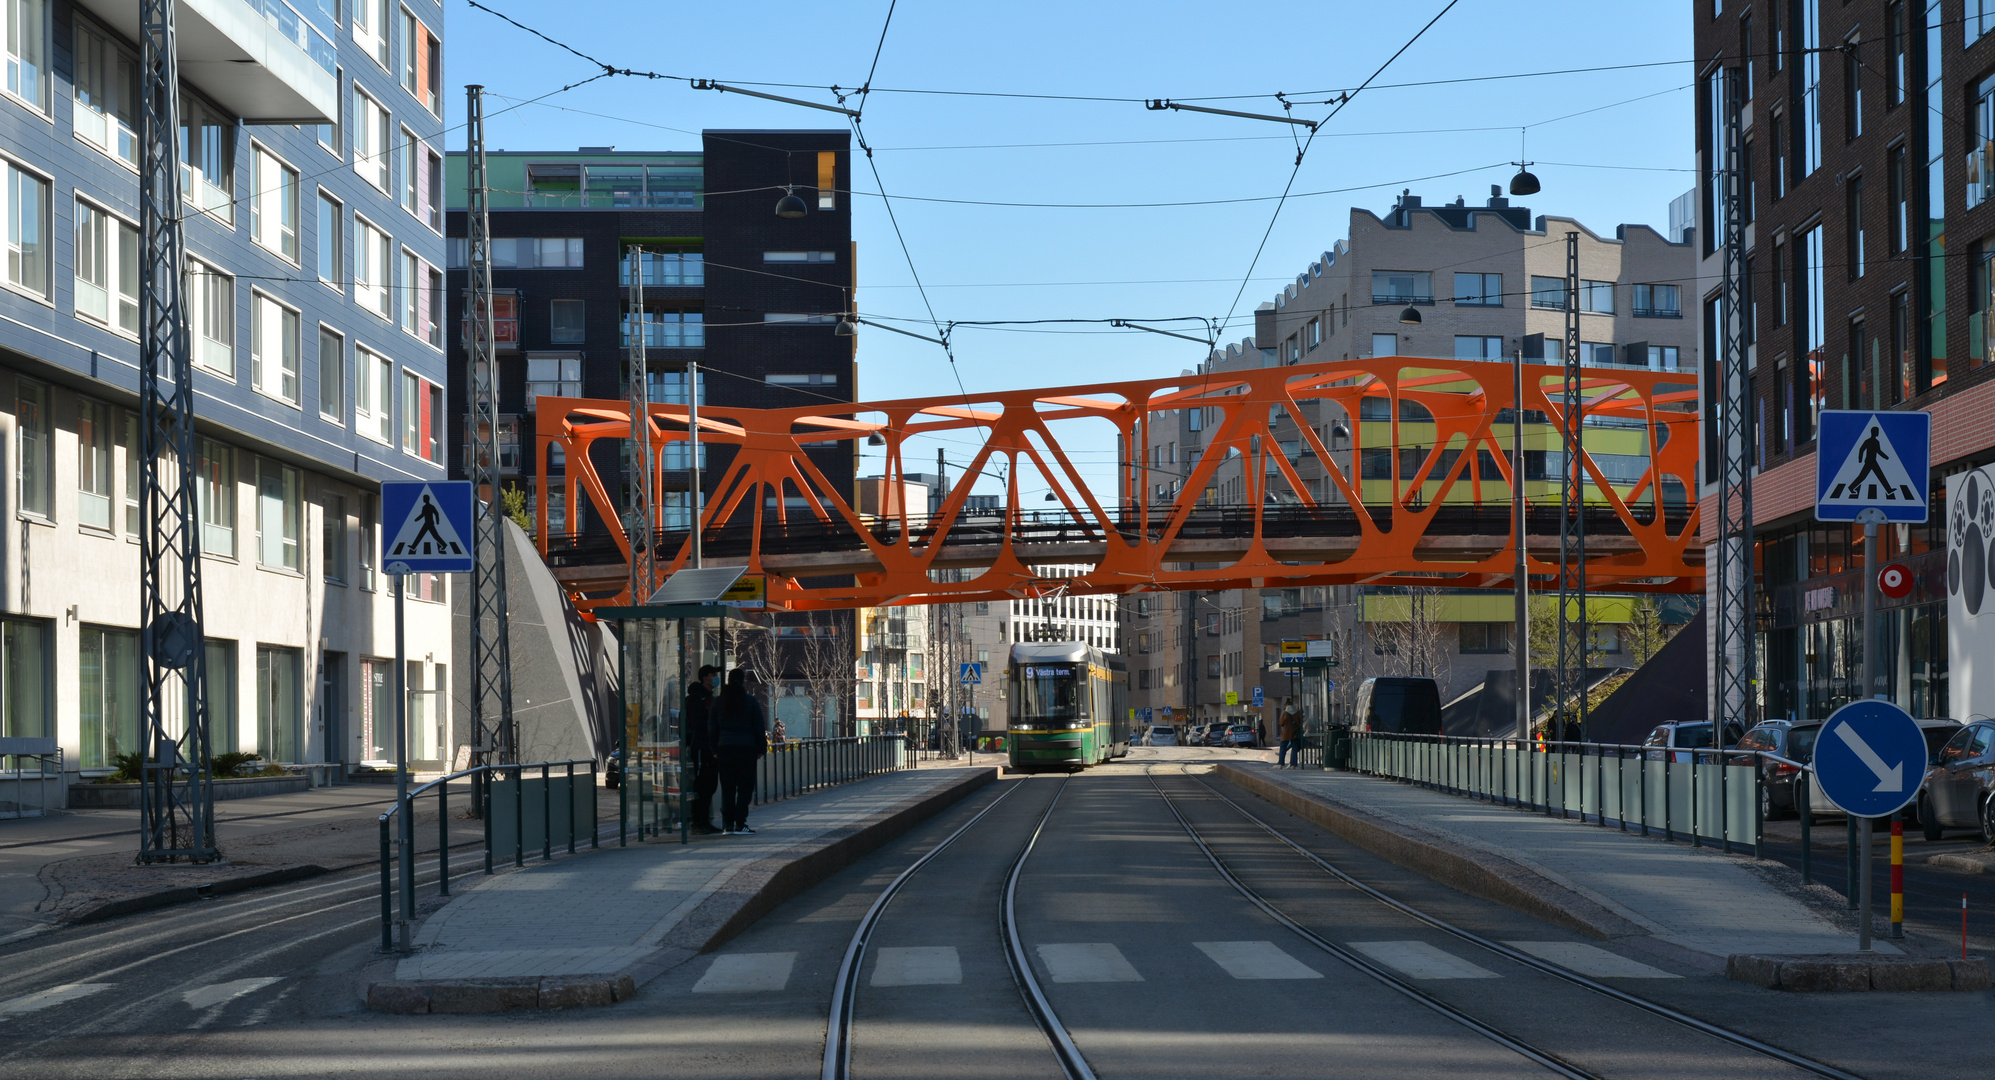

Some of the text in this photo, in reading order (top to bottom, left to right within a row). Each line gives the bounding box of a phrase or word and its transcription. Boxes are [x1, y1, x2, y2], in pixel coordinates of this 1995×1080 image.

[1025, 666, 1034, 679] 9
[1254, 687, 1262, 697] P
[1145, 707, 1151, 716] P
